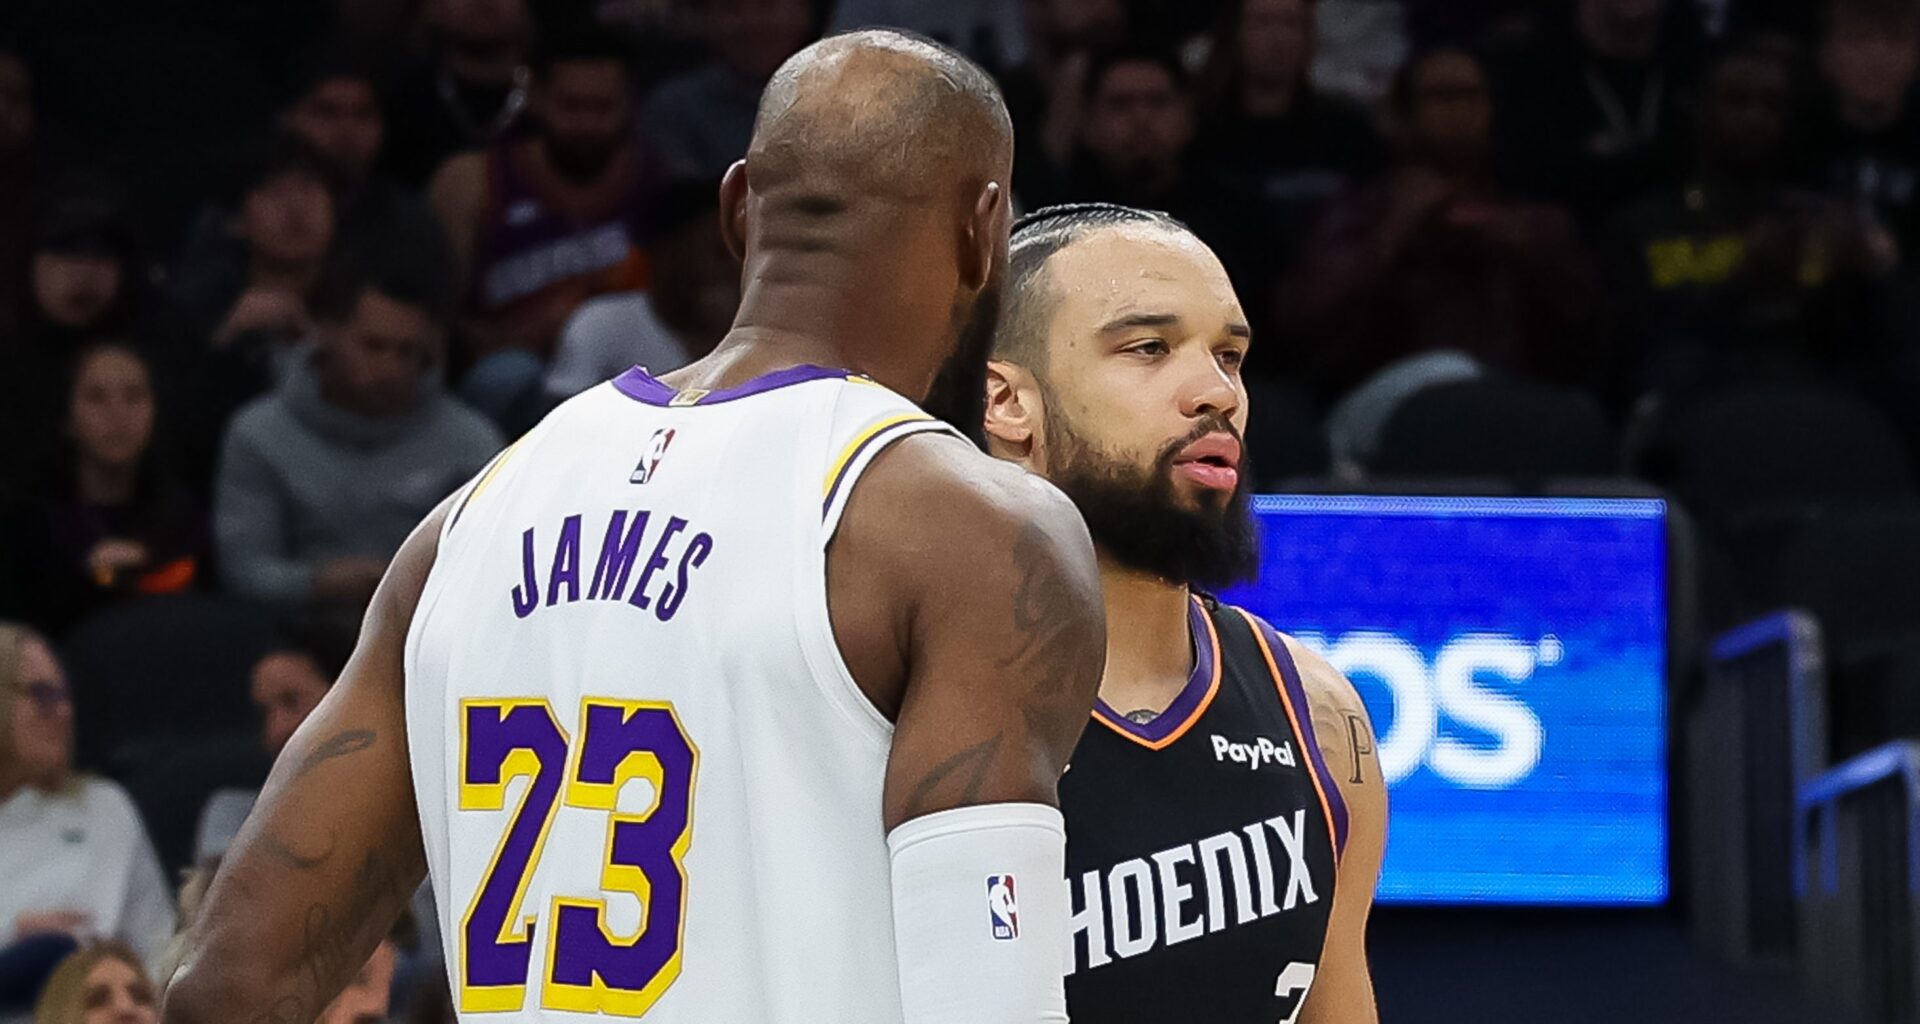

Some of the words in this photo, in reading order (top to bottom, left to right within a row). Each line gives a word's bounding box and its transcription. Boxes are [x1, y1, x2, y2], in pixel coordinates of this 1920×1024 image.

[511, 509, 713, 622] JAMES
[1210, 734, 1296, 770] PayPal
[459, 696, 701, 1017] 23
[1063, 809, 1319, 978] HOENIX
